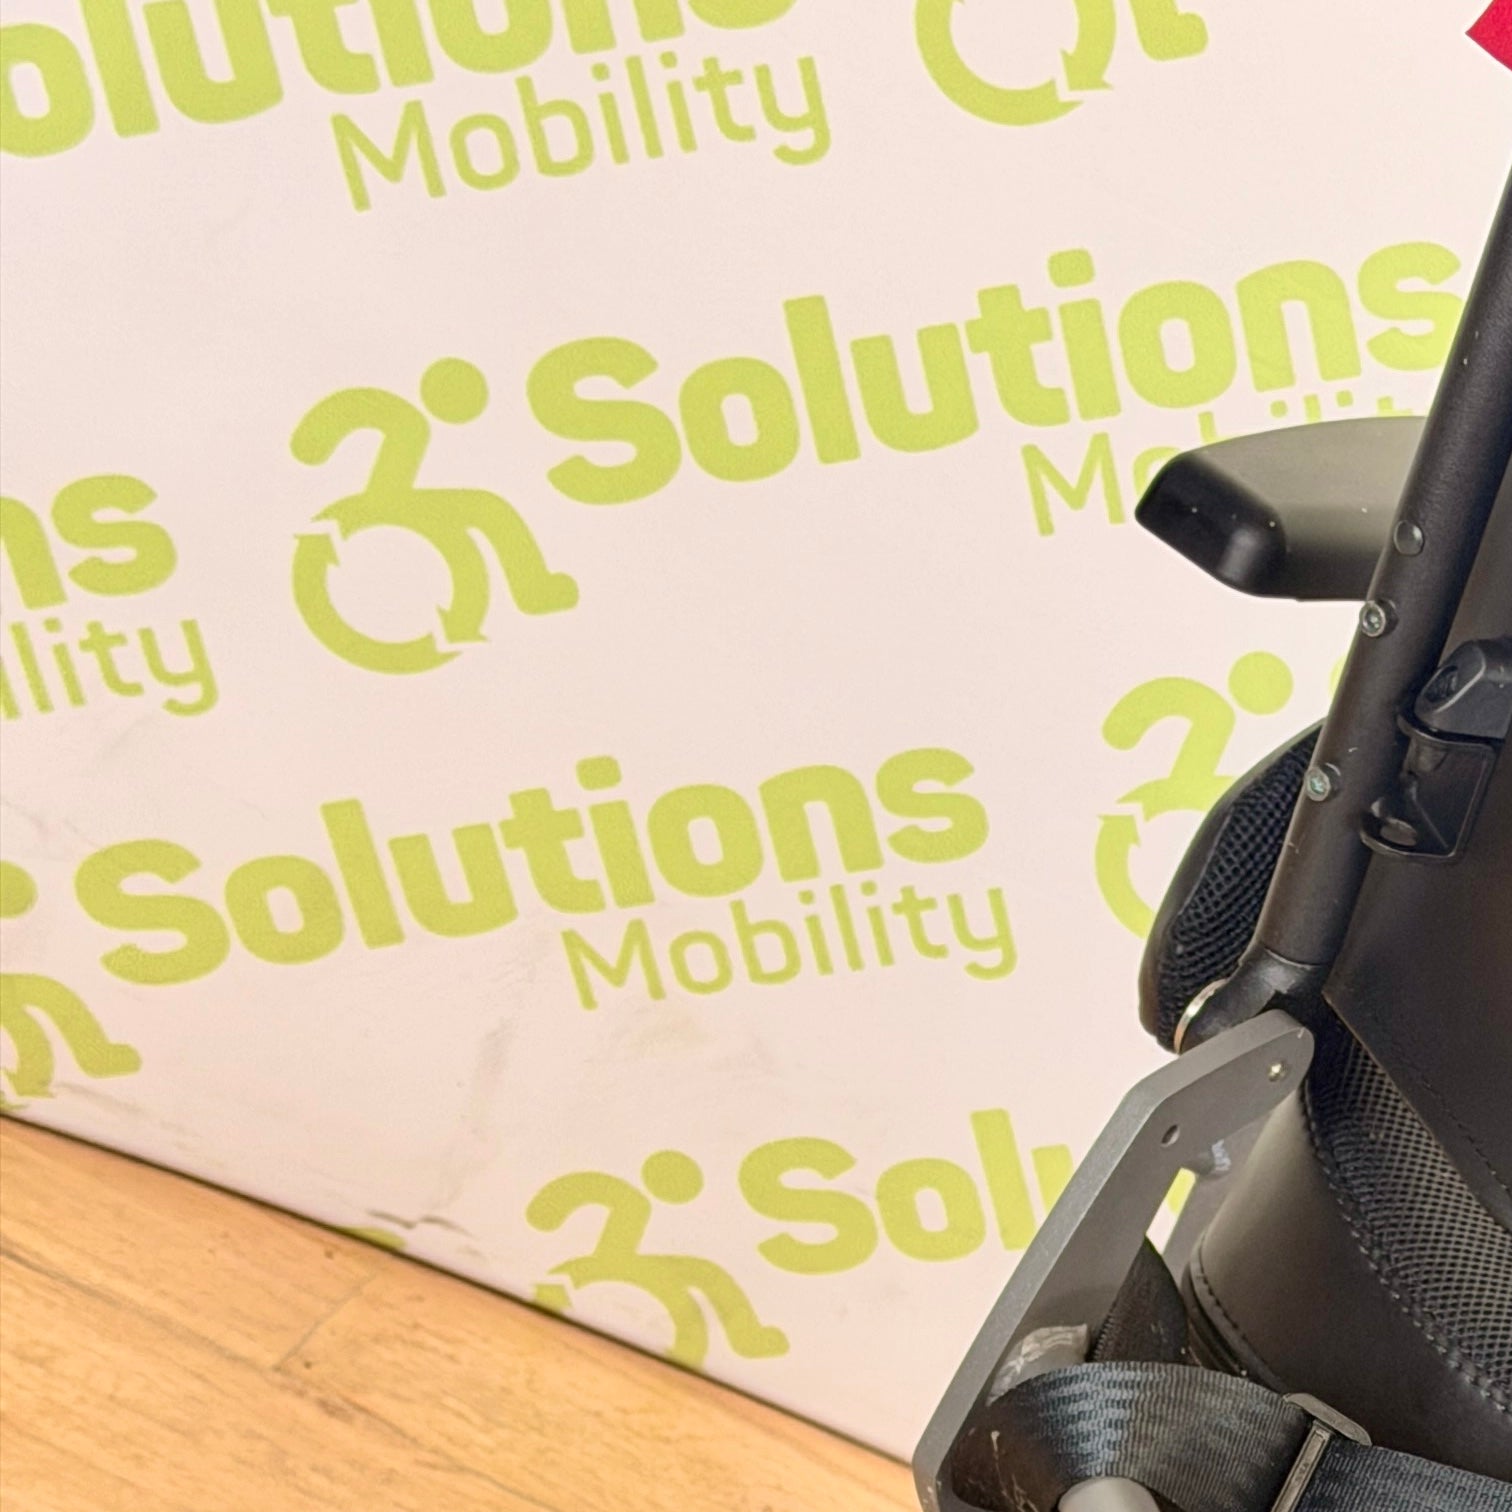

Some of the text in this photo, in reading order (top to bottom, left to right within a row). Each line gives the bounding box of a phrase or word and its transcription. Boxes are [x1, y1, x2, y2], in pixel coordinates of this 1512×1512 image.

[330, 51, 831, 212] Mobility
[526, 242, 1468, 505] Solutions
[72, 747, 989, 987] Solutions
[560, 881, 1018, 1012] Mobility
[736, 1108, 1076, 1276] Sol
